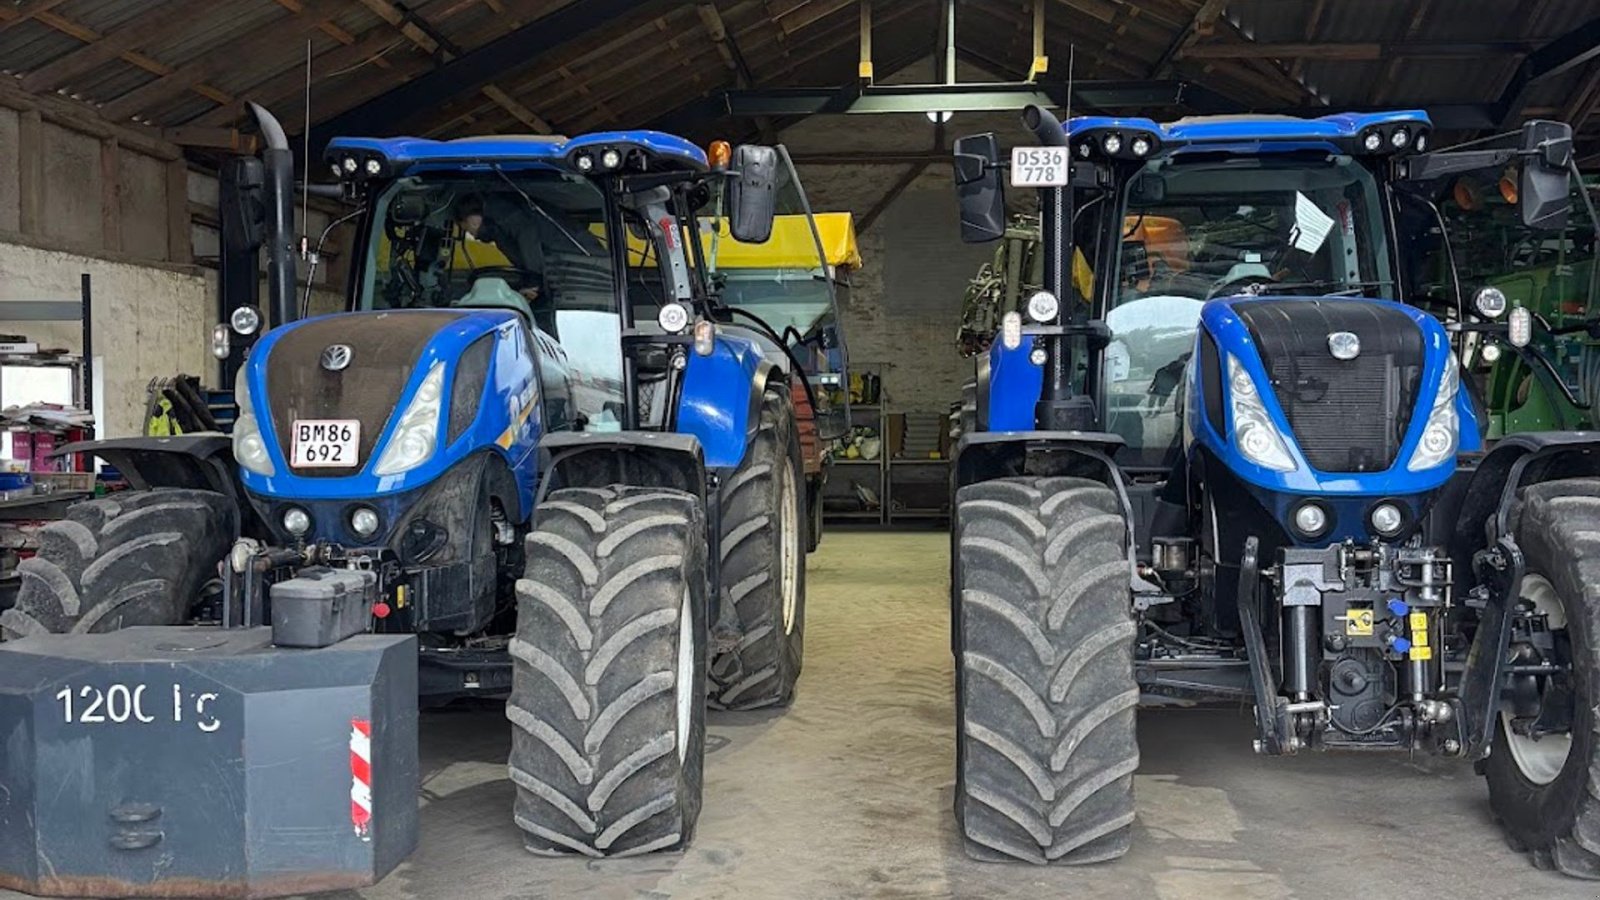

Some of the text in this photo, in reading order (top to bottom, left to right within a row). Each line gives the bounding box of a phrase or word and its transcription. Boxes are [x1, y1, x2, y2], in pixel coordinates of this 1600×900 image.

[1017, 150, 1062, 166] DS36
[1024, 166, 1055, 182] 778
[300, 424, 352, 442] BM86
[306, 444, 342, 462] 692
